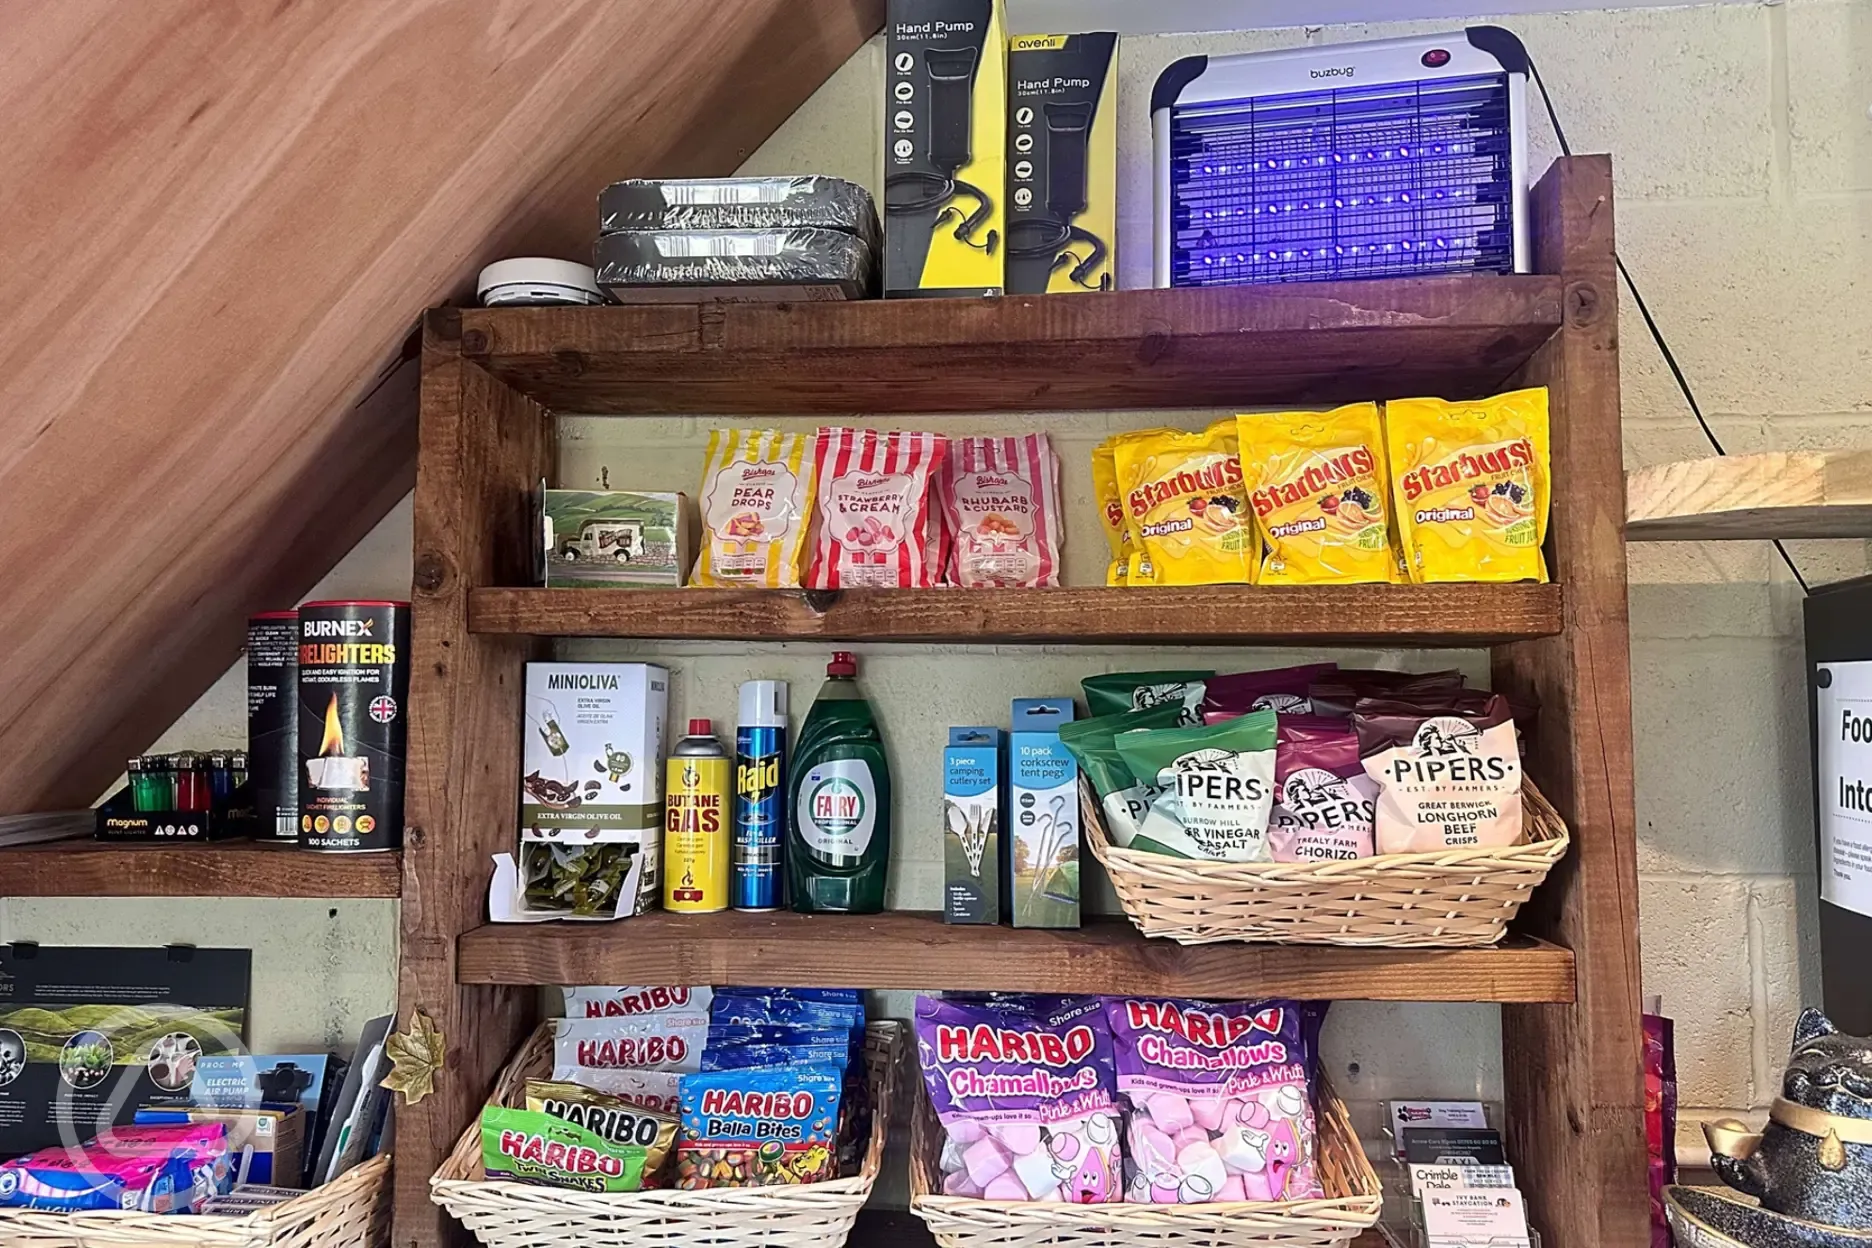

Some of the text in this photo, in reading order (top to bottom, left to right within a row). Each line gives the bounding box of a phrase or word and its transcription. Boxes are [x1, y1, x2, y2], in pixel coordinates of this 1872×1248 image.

[896, 21, 974, 33] Hand Pump
[1310, 66, 1355, 79] buzbug
[1017, 77, 1090, 89] Hand Pump
[1402, 438, 1534, 501] Starburst
[1128, 454, 1244, 518] Starburs
[733, 487, 775, 500] PEAR
[838, 494, 904, 503] STRAWBERRY
[731, 498, 772, 510] DROPS
[962, 496, 1028, 505] RHUBARB
[839, 502, 900, 514] & CREAM
[973, 505, 1028, 514] CUSTARD
[1415, 507, 1475, 524] Original
[1141, 518, 1193, 538] Original
[1269, 516, 1326, 539] Original
[304, 618, 374, 637] BURNEX
[548, 674, 618, 690] MINIOLIVA
[1020, 747, 1052, 756] 10 pack
[949, 758, 976, 767] 3 piece
[1020, 758, 1070, 767] corkscrew
[737, 757, 780, 795] Raid
[950, 768, 985, 777] camping
[1020, 768, 1065, 779] tent pegs
[1394, 757, 1505, 782] PIPERS
[950, 777, 991, 785] cutlery set
[667, 794, 720, 807] BUTANE
[816, 795, 857, 817] FAIRY
[1450, 801, 1492, 809] BERWICK
[537, 812, 560, 820] EXTRA
[561, 812, 586, 820] VIRGIN
[666, 808, 720, 833] GAS
[1183, 817, 1217, 825] BURROW
[1278, 800, 1373, 831] PIPERS
[1417, 807, 1498, 823] LONGHORN
[1203, 828, 1260, 840] VINEGAR
[1444, 823, 1477, 834] BEEF
[321, 838, 360, 846] SACHETS
[1297, 837, 1358, 848] TREALY FARM
[1445, 836, 1478, 845] CRISPS
[1295, 846, 1358, 860] CHORIZO
[821, 990, 844, 998] Share
[585, 985, 691, 1019] HARIBO
[1048, 1006, 1083, 1027] Share
[576, 1035, 688, 1068] HARIBO
[936, 1024, 1095, 1068] HARIBO
[1138, 1034, 1287, 1070] Chamallows
[206, 1078, 248, 1087] ELECTRIC
[948, 1066, 1097, 1098] Chamallows
[1227, 1071, 1261, 1095] Pink
[204, 1087, 250, 1096] AIR PUMP
[701, 1089, 814, 1120] HARIBO
[1038, 1101, 1072, 1124] Pink
[544, 1099, 661, 1147] HARIBO
[707, 1119, 802, 1138] Balla Bites
[500, 1129, 624, 1179] HARIBO
[1416, 1168, 1458, 1180] Crimble
